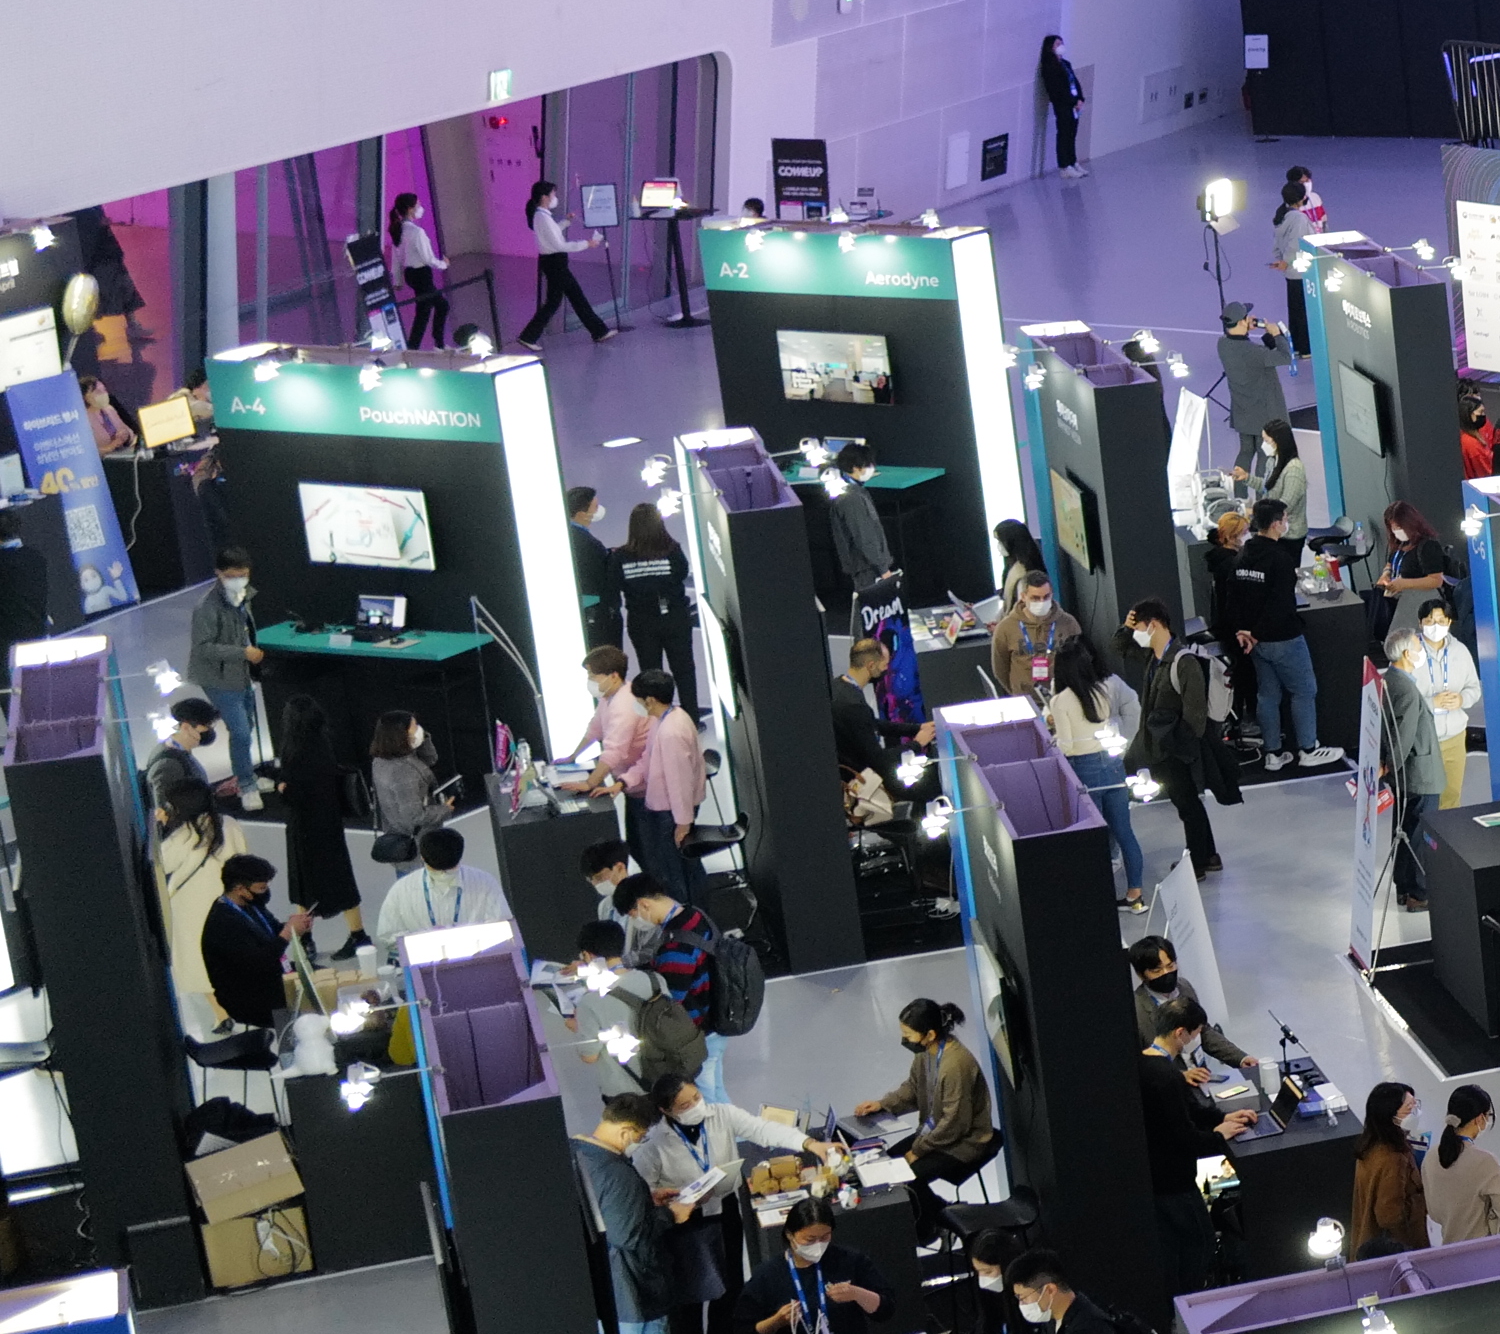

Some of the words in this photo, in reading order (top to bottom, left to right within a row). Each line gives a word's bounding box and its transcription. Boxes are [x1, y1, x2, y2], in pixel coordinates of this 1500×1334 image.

[719, 262, 749, 279] A-2
[864, 269, 942, 289] Aerodyne
[231, 396, 267, 418] A-4
[359, 405, 482, 430] PouchNATION
[861, 597, 904, 632] Dream
